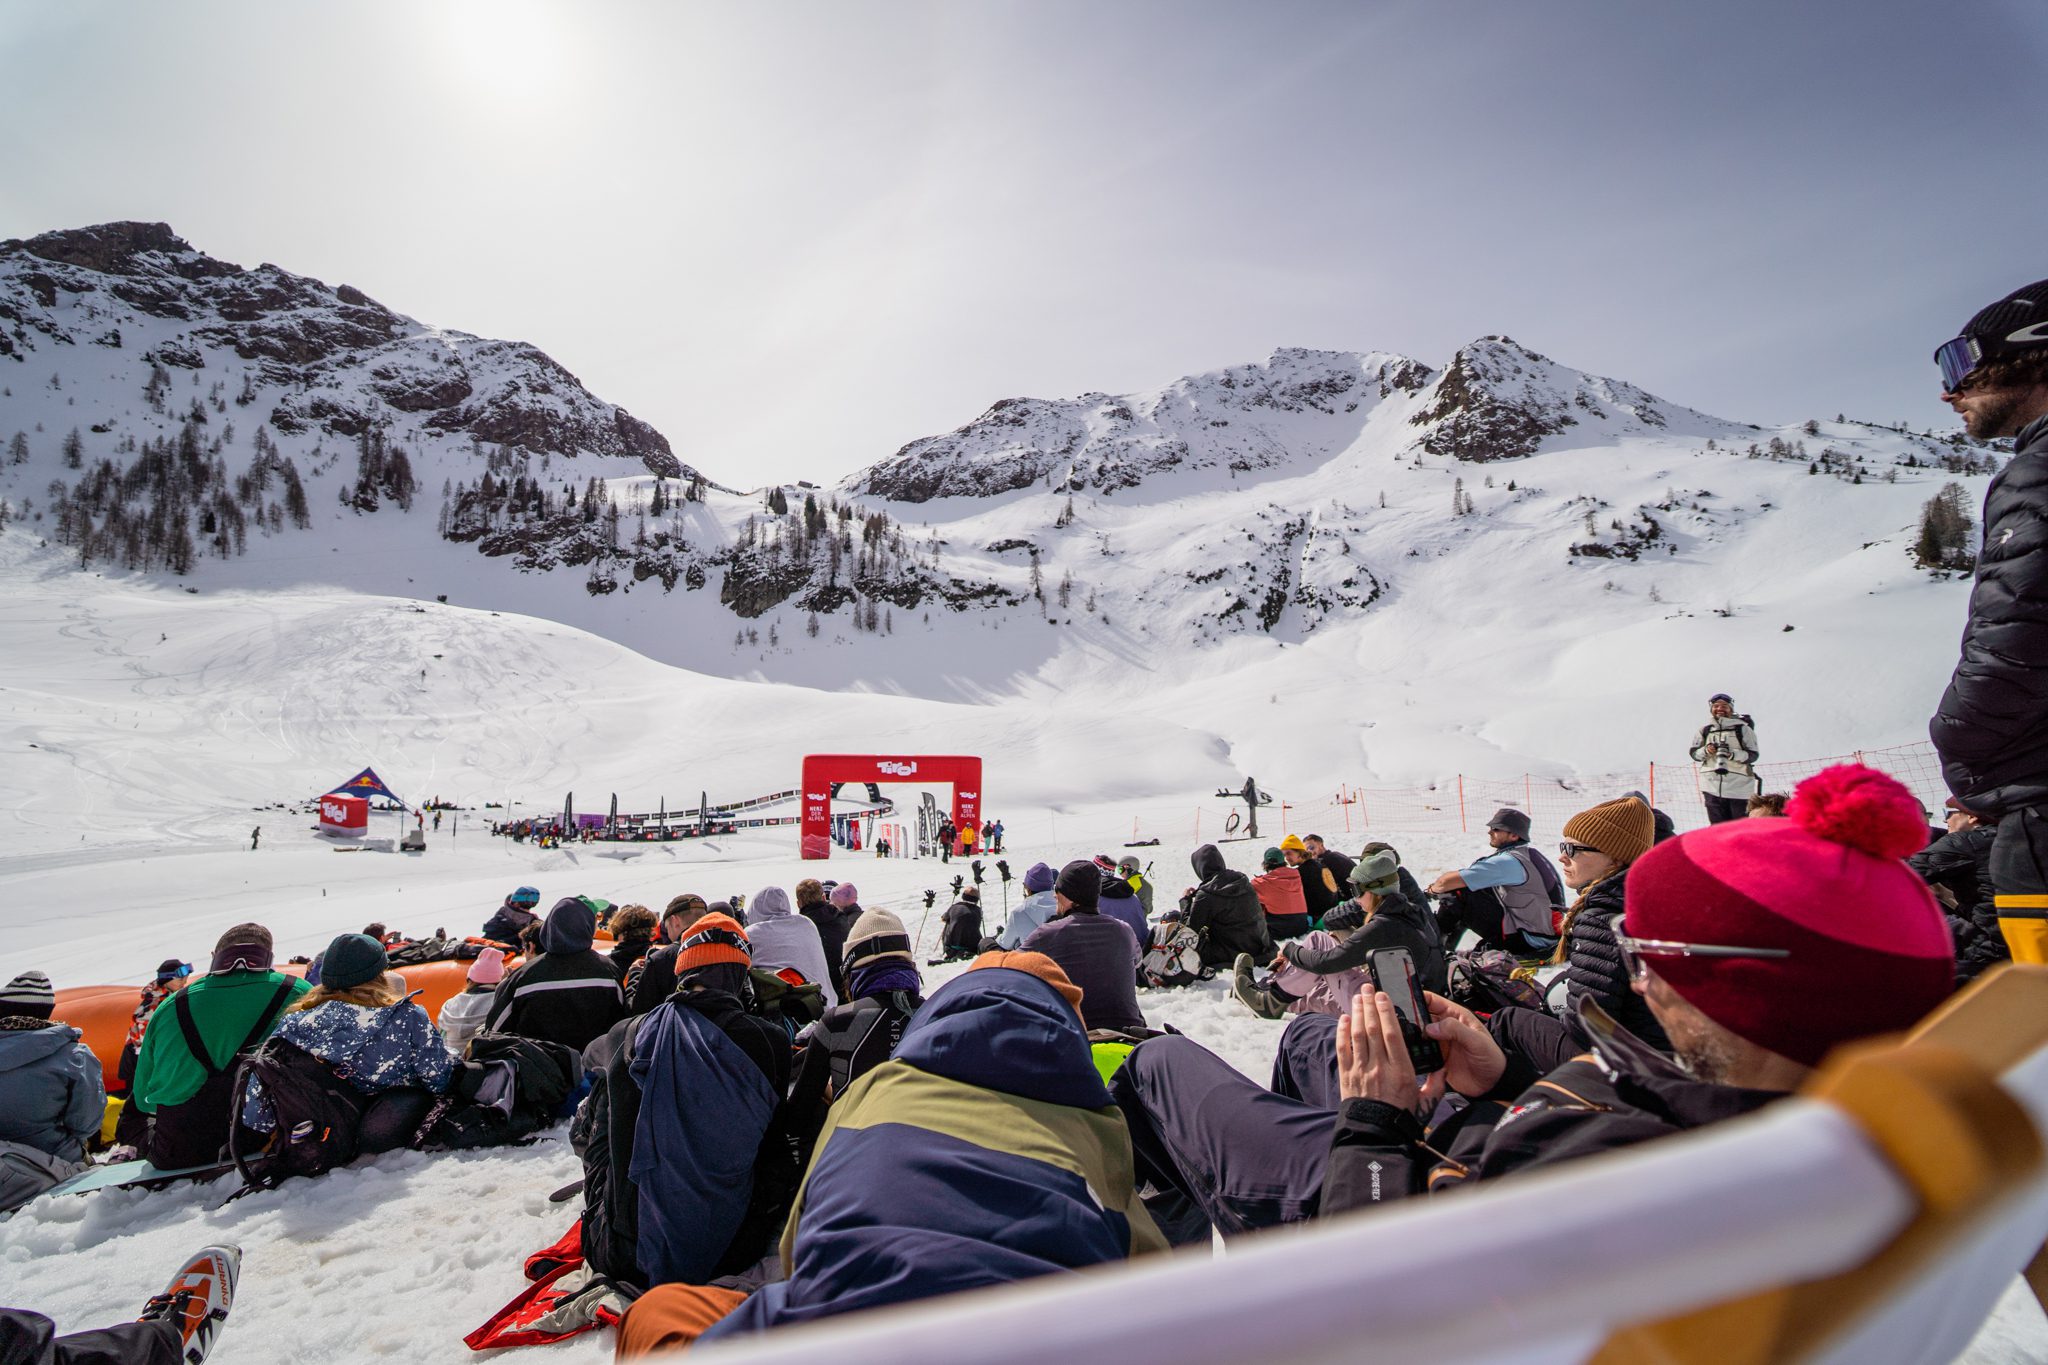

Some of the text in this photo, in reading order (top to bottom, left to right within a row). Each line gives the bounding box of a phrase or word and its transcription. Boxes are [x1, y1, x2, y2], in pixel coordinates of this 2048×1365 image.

[877, 761, 917, 776] Tirol
[322, 802, 347, 823] Tirol
[215, 1254, 229, 1306] DYNAFIT
